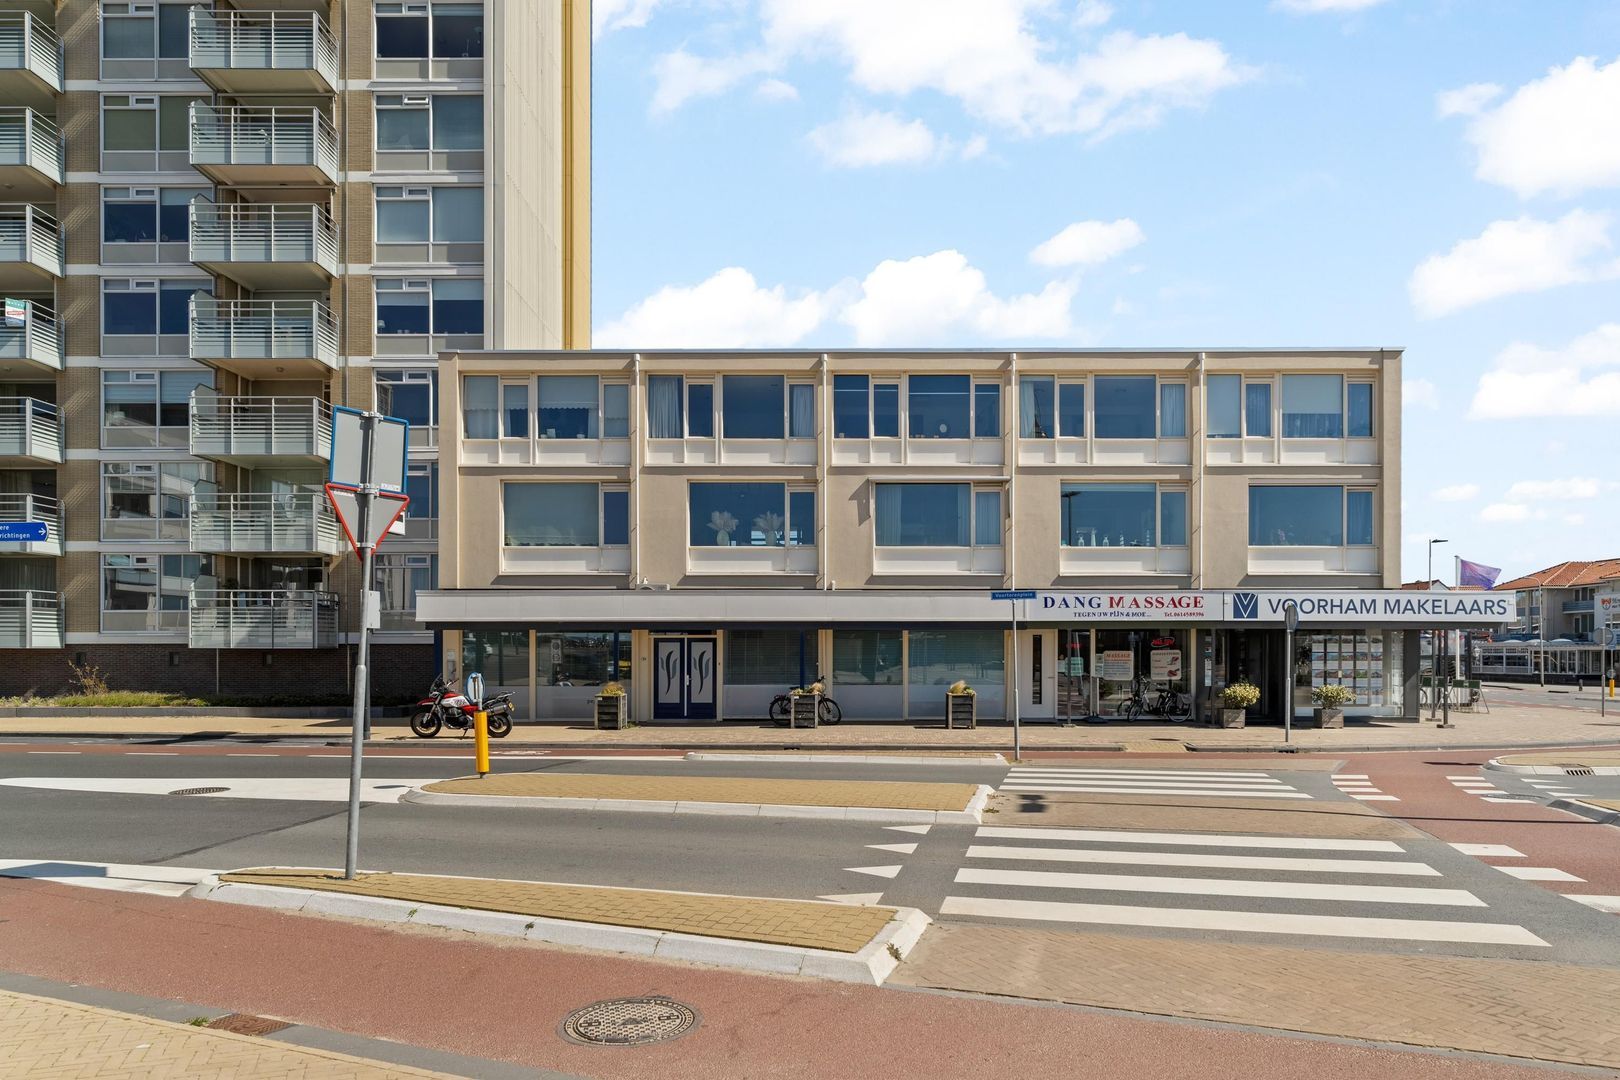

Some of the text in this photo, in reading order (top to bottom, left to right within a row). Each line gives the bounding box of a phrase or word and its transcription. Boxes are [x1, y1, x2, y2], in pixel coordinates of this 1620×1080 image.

[1043, 596, 1205, 609] DANG MASSAGE
[1268, 598, 1507, 615] VOORHAM MAKELAARS
